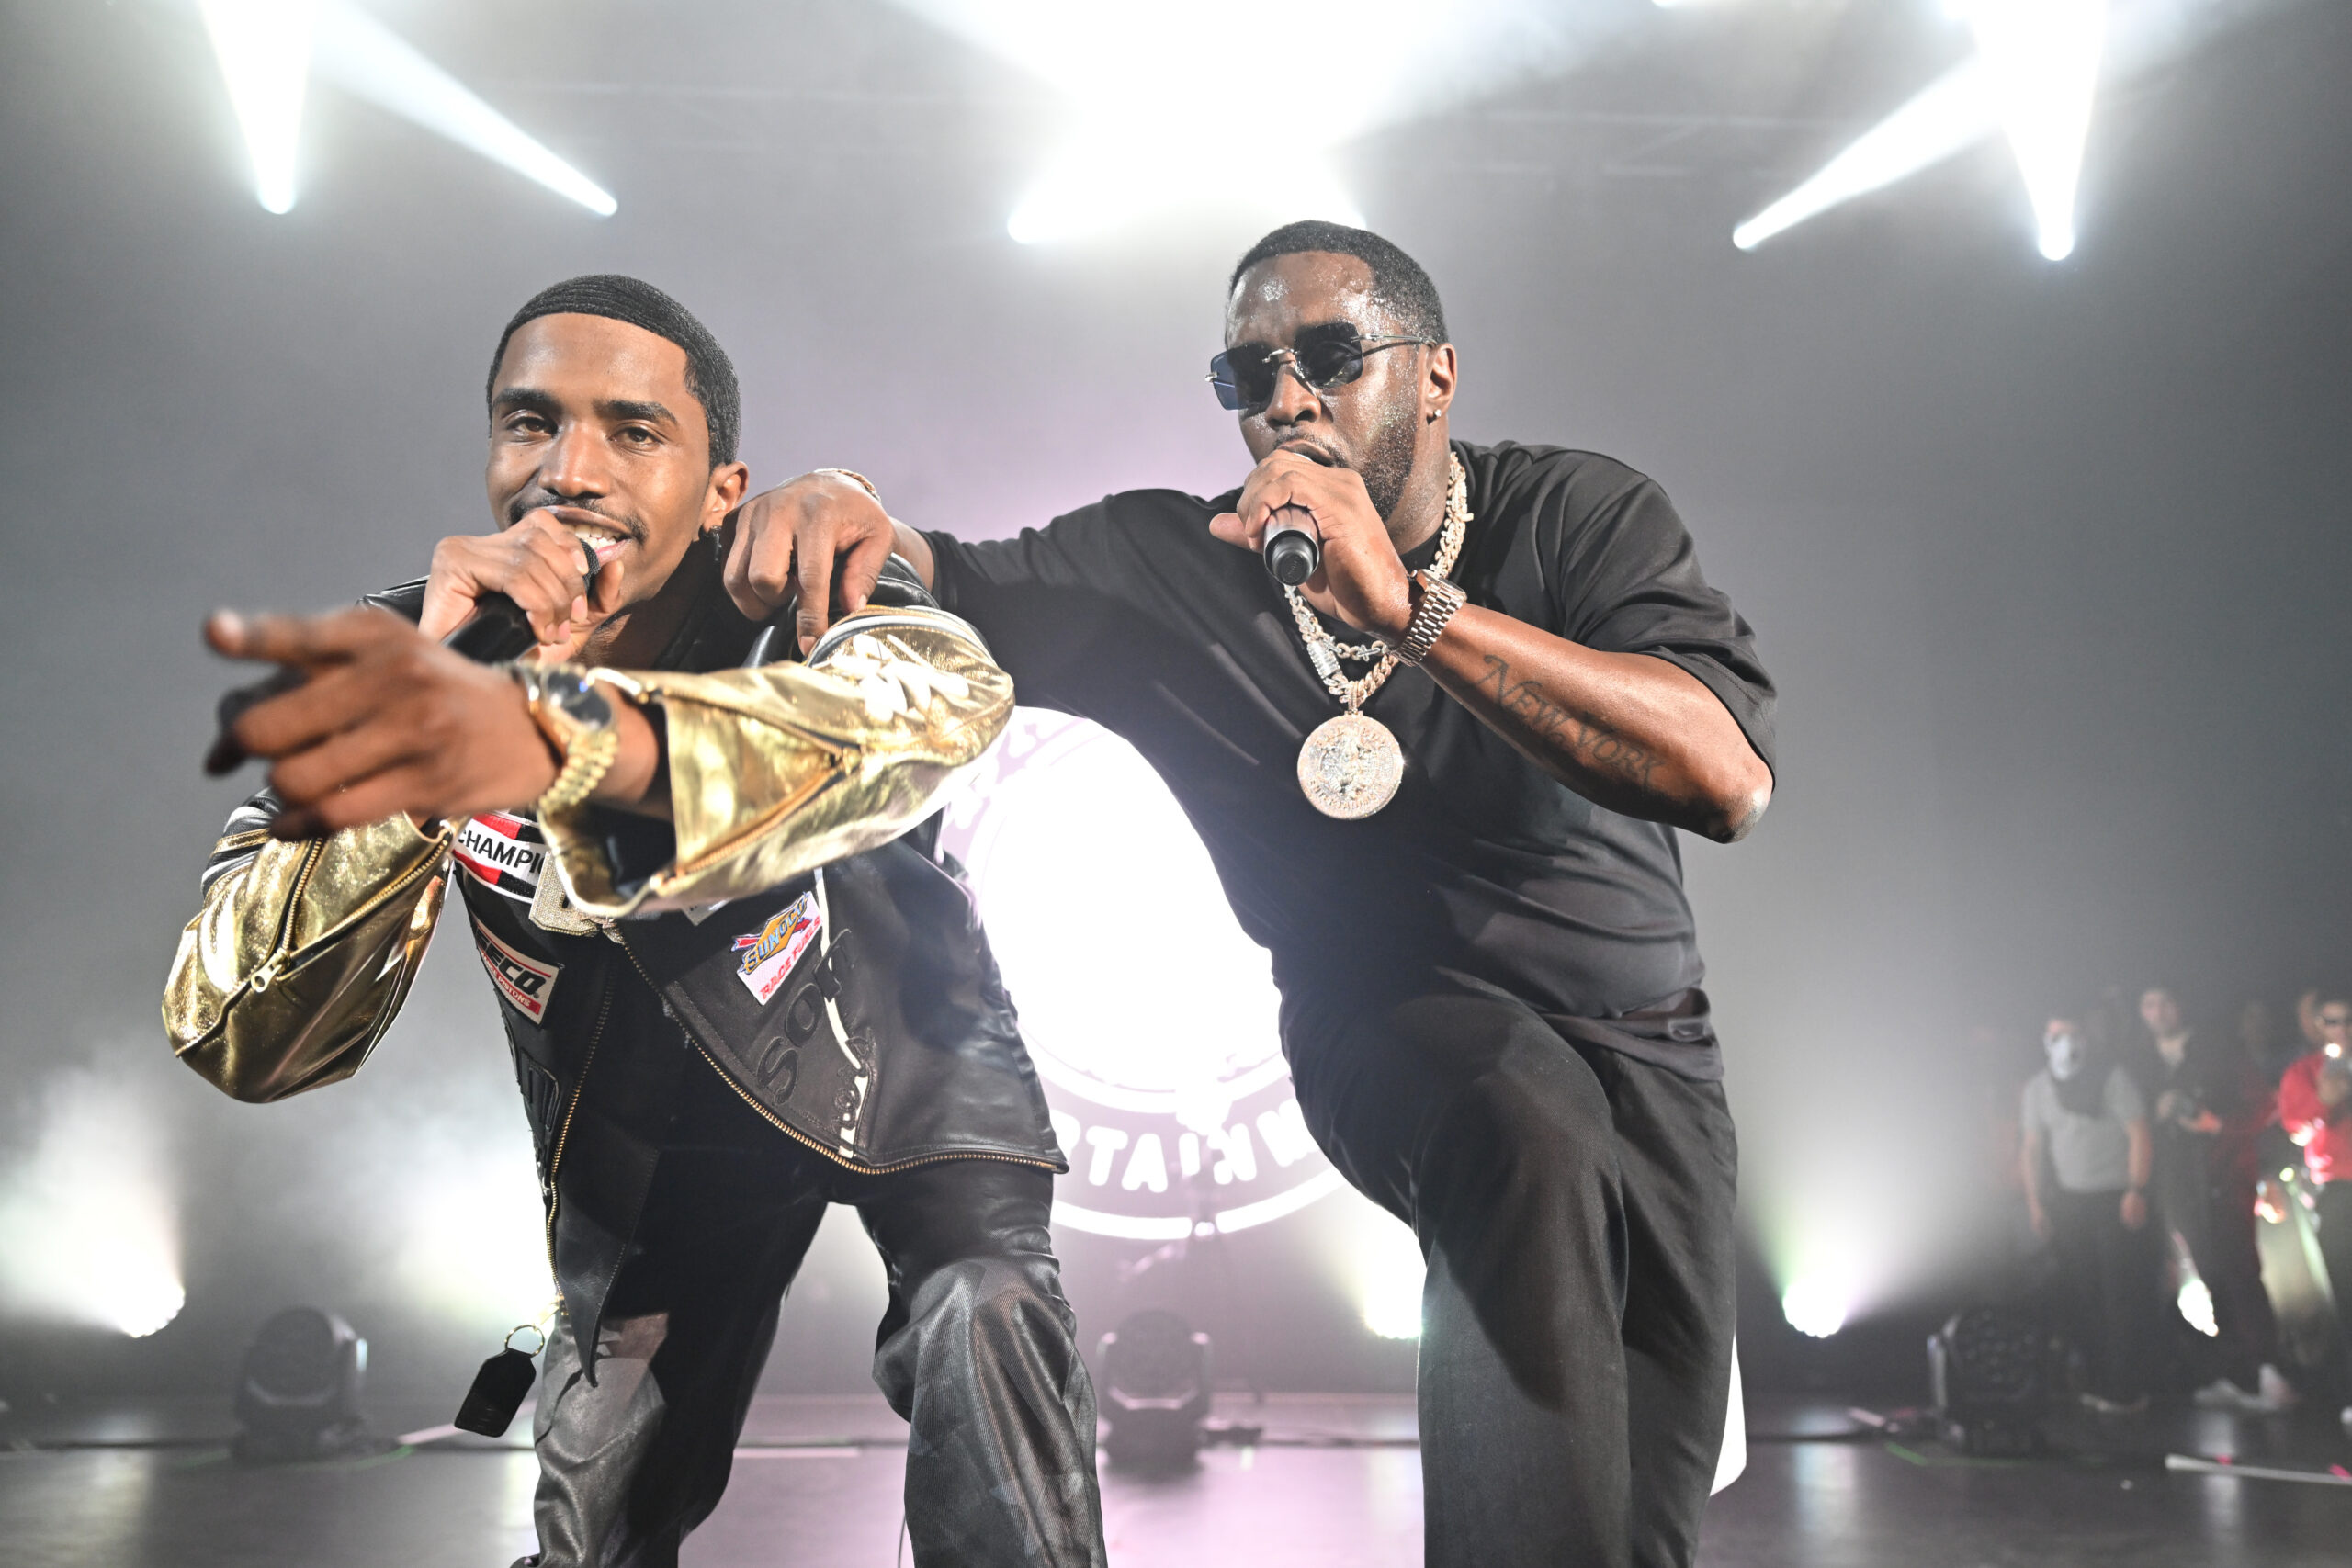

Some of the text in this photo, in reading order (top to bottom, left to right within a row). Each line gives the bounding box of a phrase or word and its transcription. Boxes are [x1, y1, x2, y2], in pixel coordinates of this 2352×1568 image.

[1476, 654, 1666, 795] NEW YORK
[458, 829, 546, 874] HAMPI
[746, 897, 806, 970] SUNOCO
[760, 915, 821, 1000] RACE FUELS
[497, 976, 531, 1008] PISTONS
